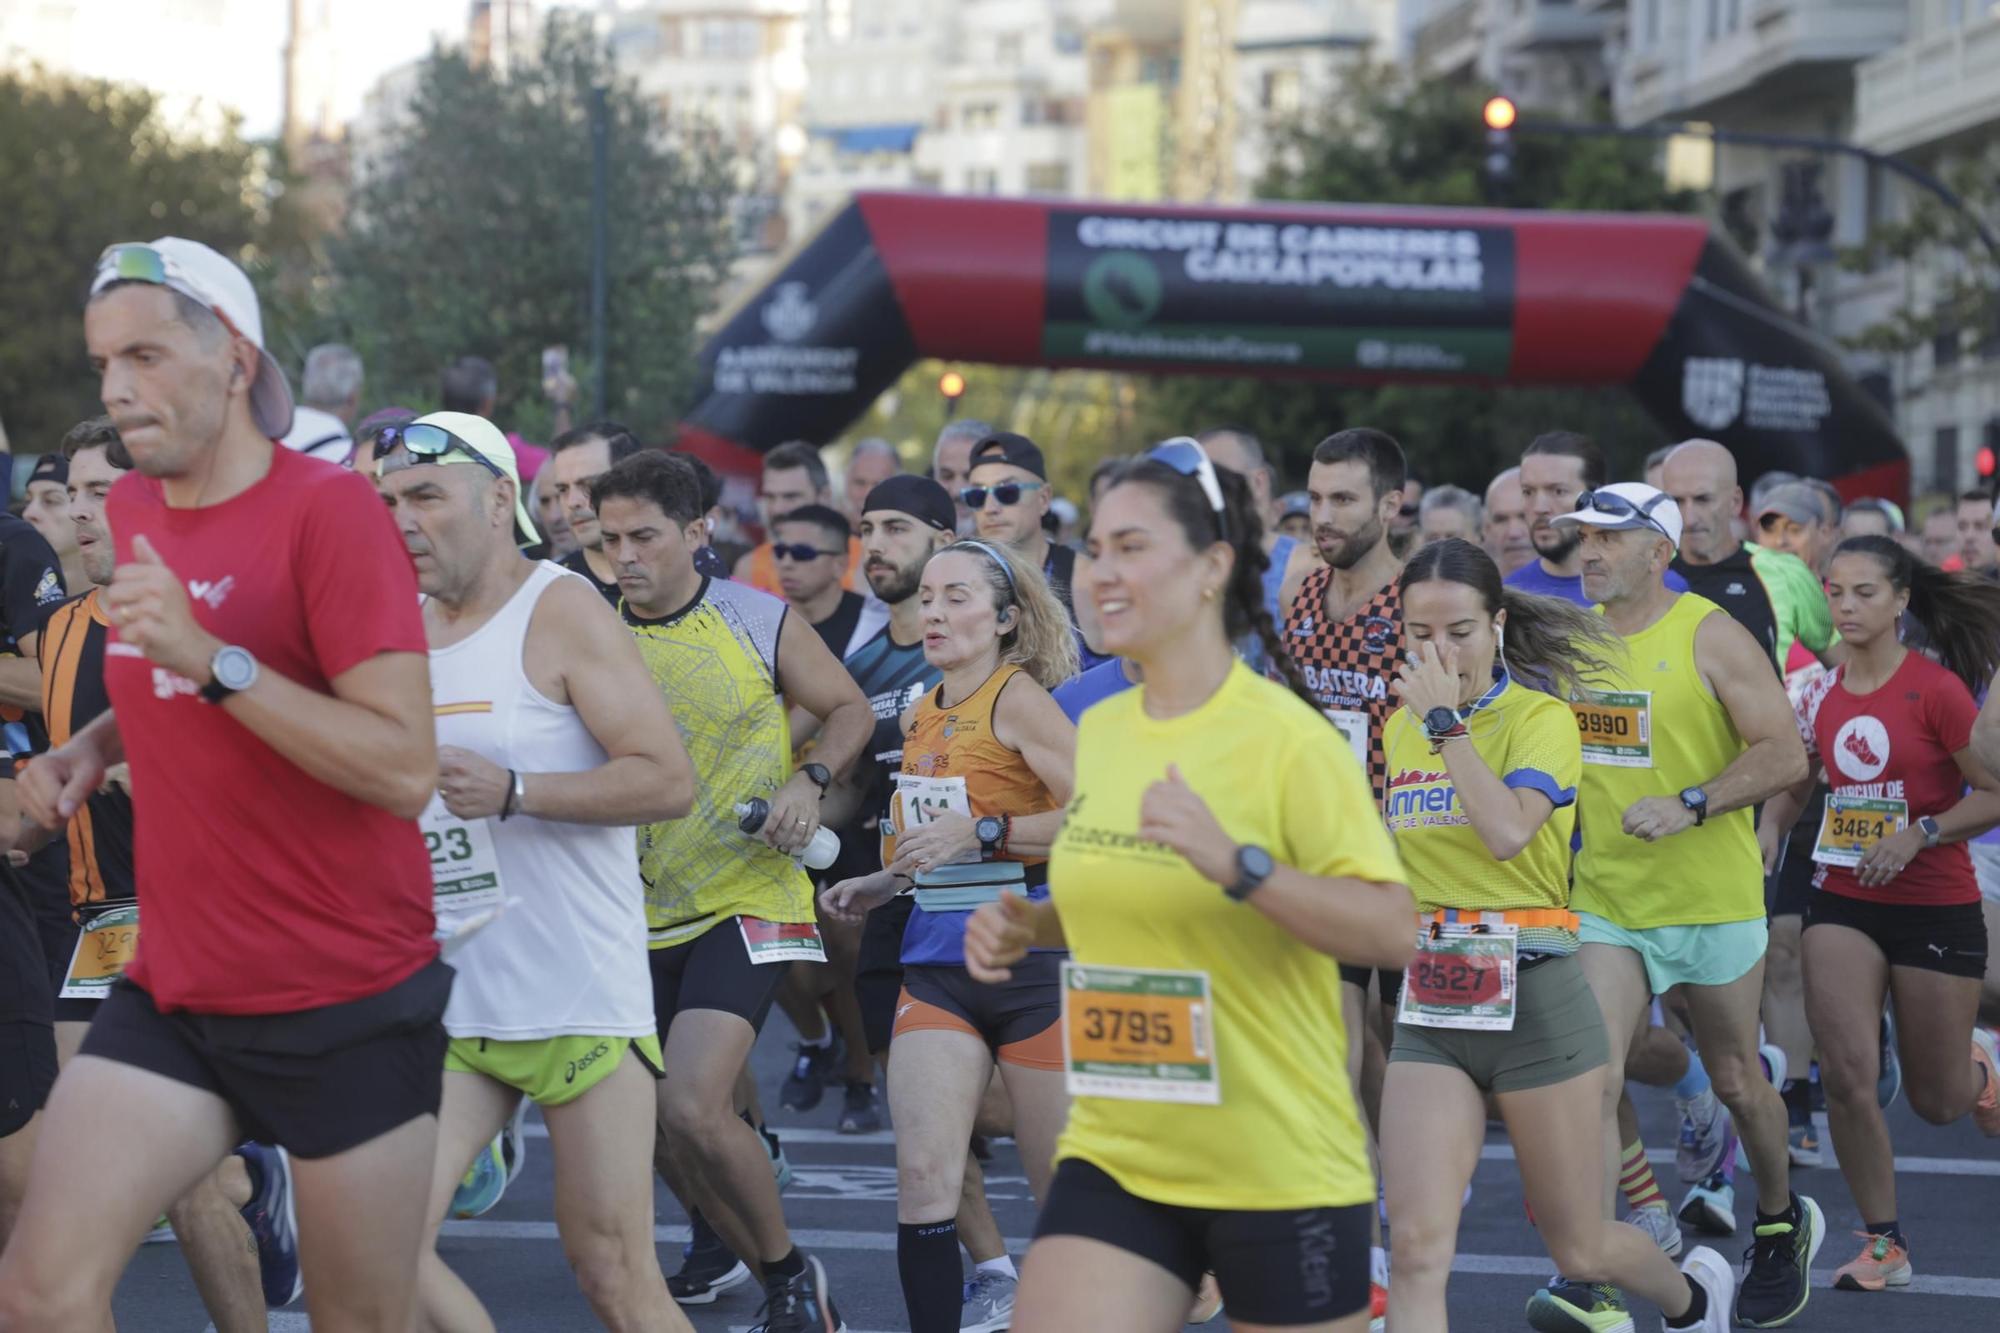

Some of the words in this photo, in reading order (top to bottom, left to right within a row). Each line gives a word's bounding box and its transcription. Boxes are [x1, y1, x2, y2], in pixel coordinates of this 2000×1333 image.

[1078, 216, 1223, 251] CIRCUIT
[1225, 223, 1276, 254] DE
[1281, 226, 1479, 260] CARRERES
[1186, 249, 1304, 284] CAIXA
[1307, 254, 1483, 291] POPULAR
[1576, 712, 1628, 736] 3990
[1886, 780, 1904, 798] DE
[1403, 817, 1417, 829] DE
[1418, 962, 1485, 992] 2527
[1083, 1006, 1174, 1046] 3795
[578, 1041, 609, 1070] asics
